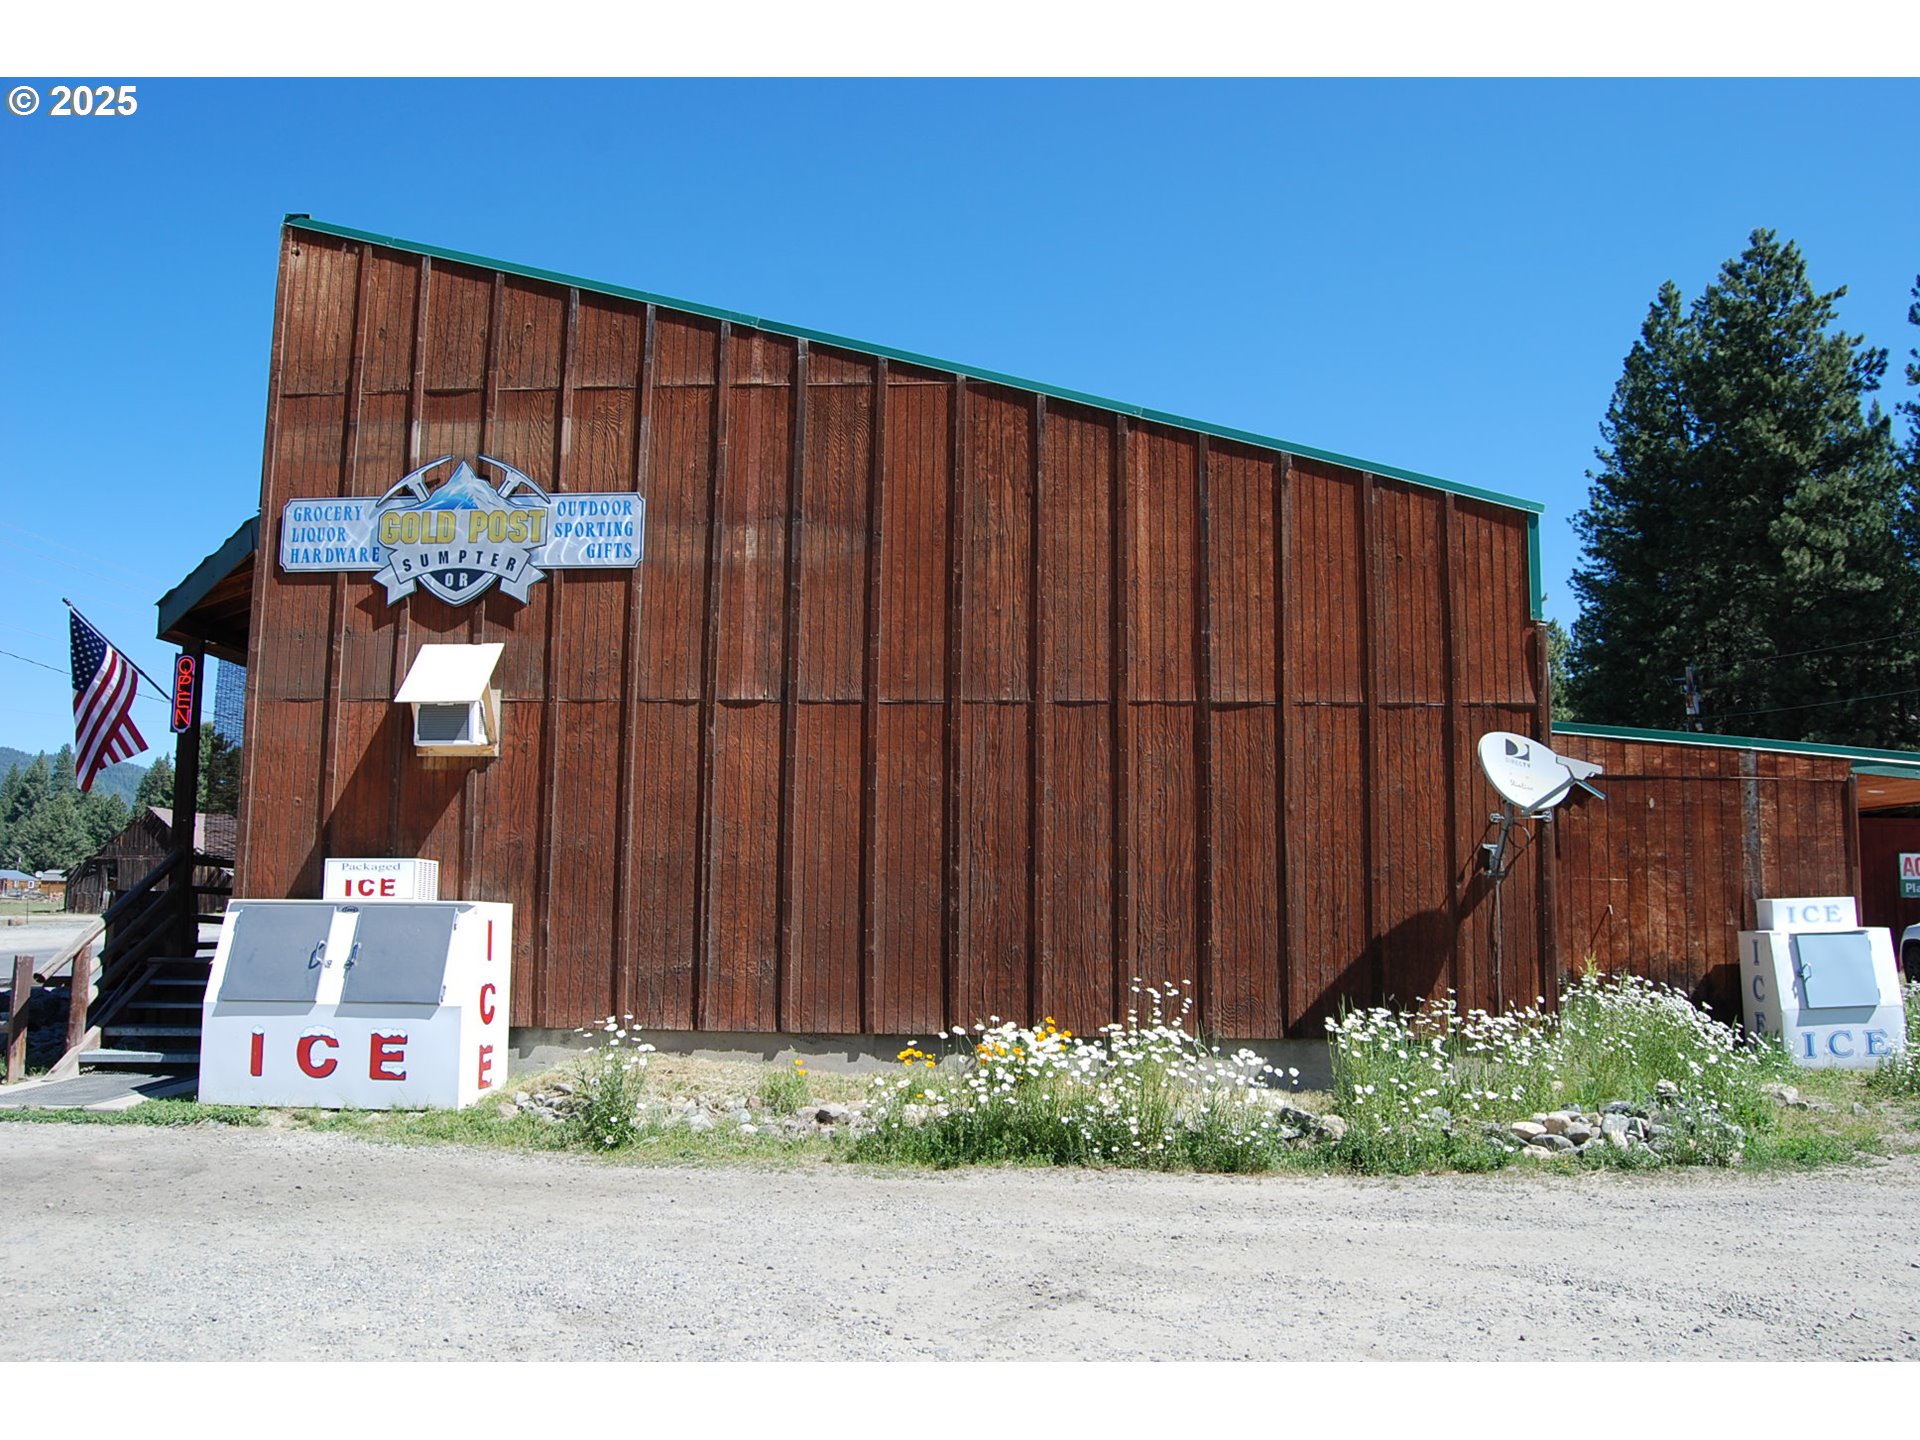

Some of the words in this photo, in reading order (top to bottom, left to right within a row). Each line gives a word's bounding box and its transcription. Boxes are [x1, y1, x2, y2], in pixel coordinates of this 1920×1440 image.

[293, 505, 363, 522] GROCERY
[557, 500, 632, 517] OUTDOOR
[292, 526, 346, 543] LIQUOR
[380, 511, 456, 545] GOLD
[468, 510, 545, 544] POST
[554, 521, 633, 538] SPORTING
[290, 546, 380, 564] HARDWARE
[586, 542, 632, 559] GIFTS
[402, 550, 517, 572] SUMPTER
[444, 572, 469, 588] OR
[175, 658, 193, 726] OPEN
[341, 862, 401, 872] Packaged
[345, 878, 396, 897] ICE
[1786, 905, 1844, 924] ICE
[1752, 939, 1767, 1035] ICE
[477, 919, 497, 1090] ICE
[250, 1025, 409, 1081] ICE
[1802, 1029, 1892, 1059] ICE
